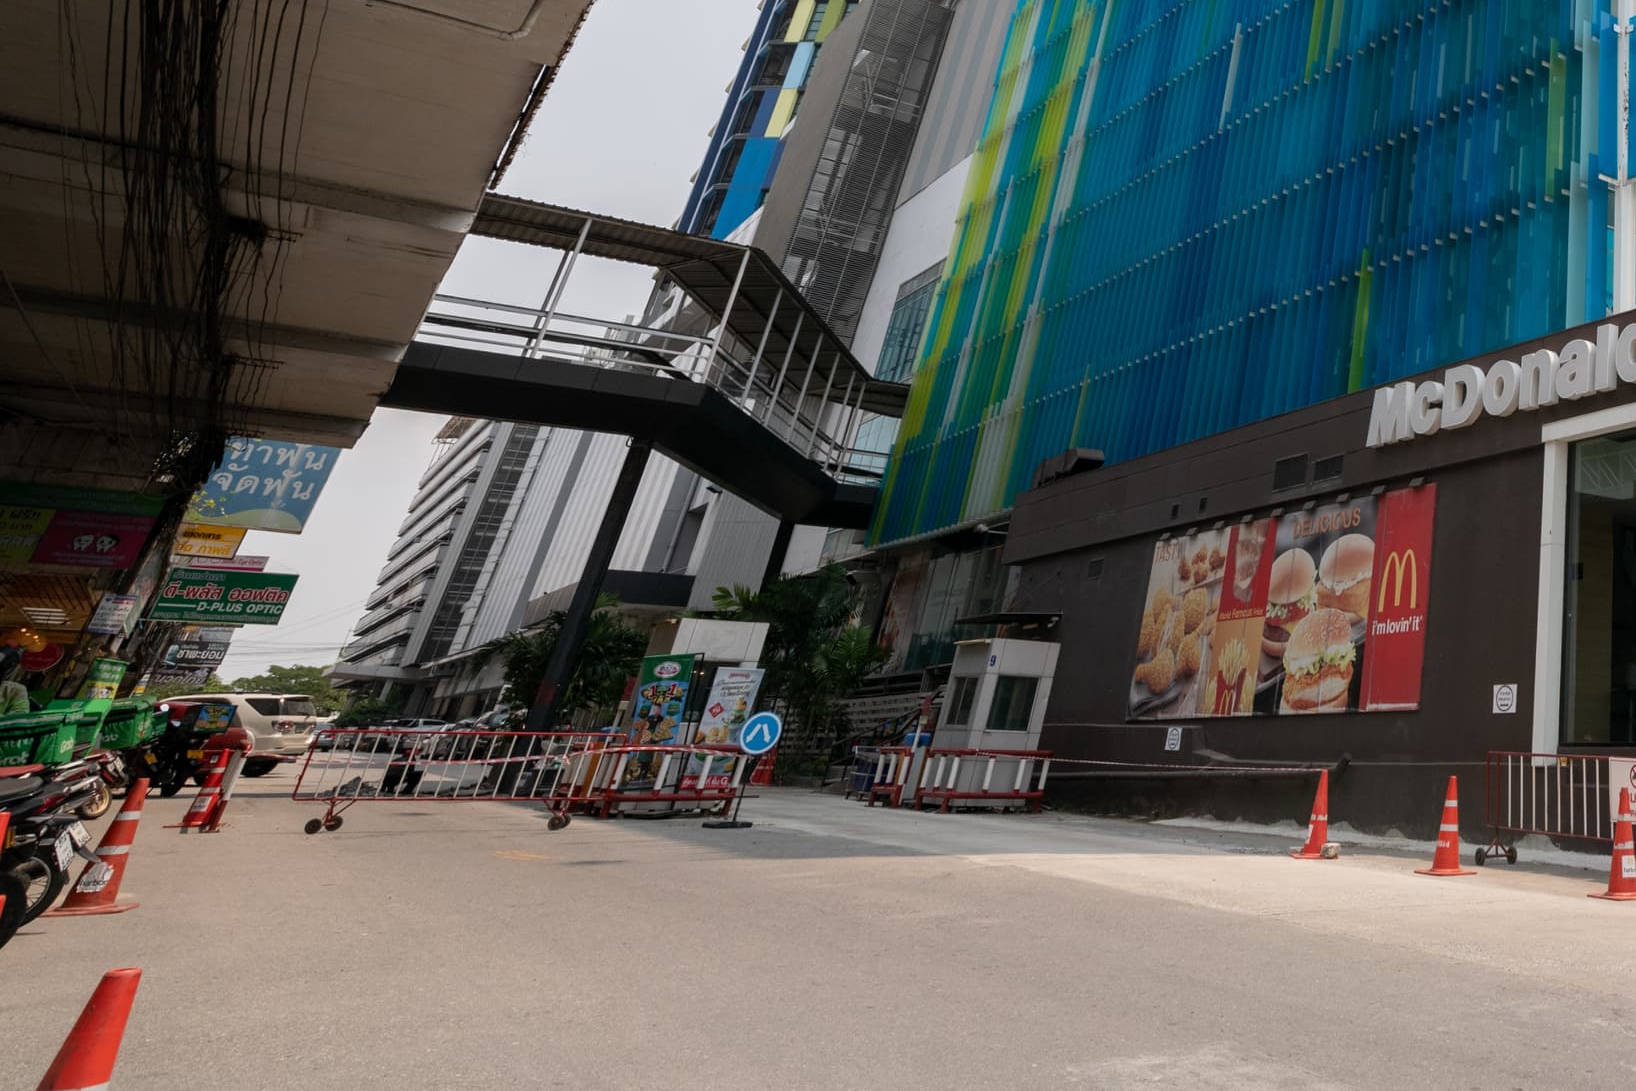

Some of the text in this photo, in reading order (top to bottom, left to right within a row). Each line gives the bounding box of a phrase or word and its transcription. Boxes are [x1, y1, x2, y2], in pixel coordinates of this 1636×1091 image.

[212, 462, 315, 501] จัดฟัน
[1294, 507, 1361, 537] DELICIOUS
[196, 601, 283, 615] D-PLUS OPTIC
[1372, 620, 1386, 636] i'm
[1386, 616, 1412, 634] lovin'
[989, 655, 997, 667] 9
